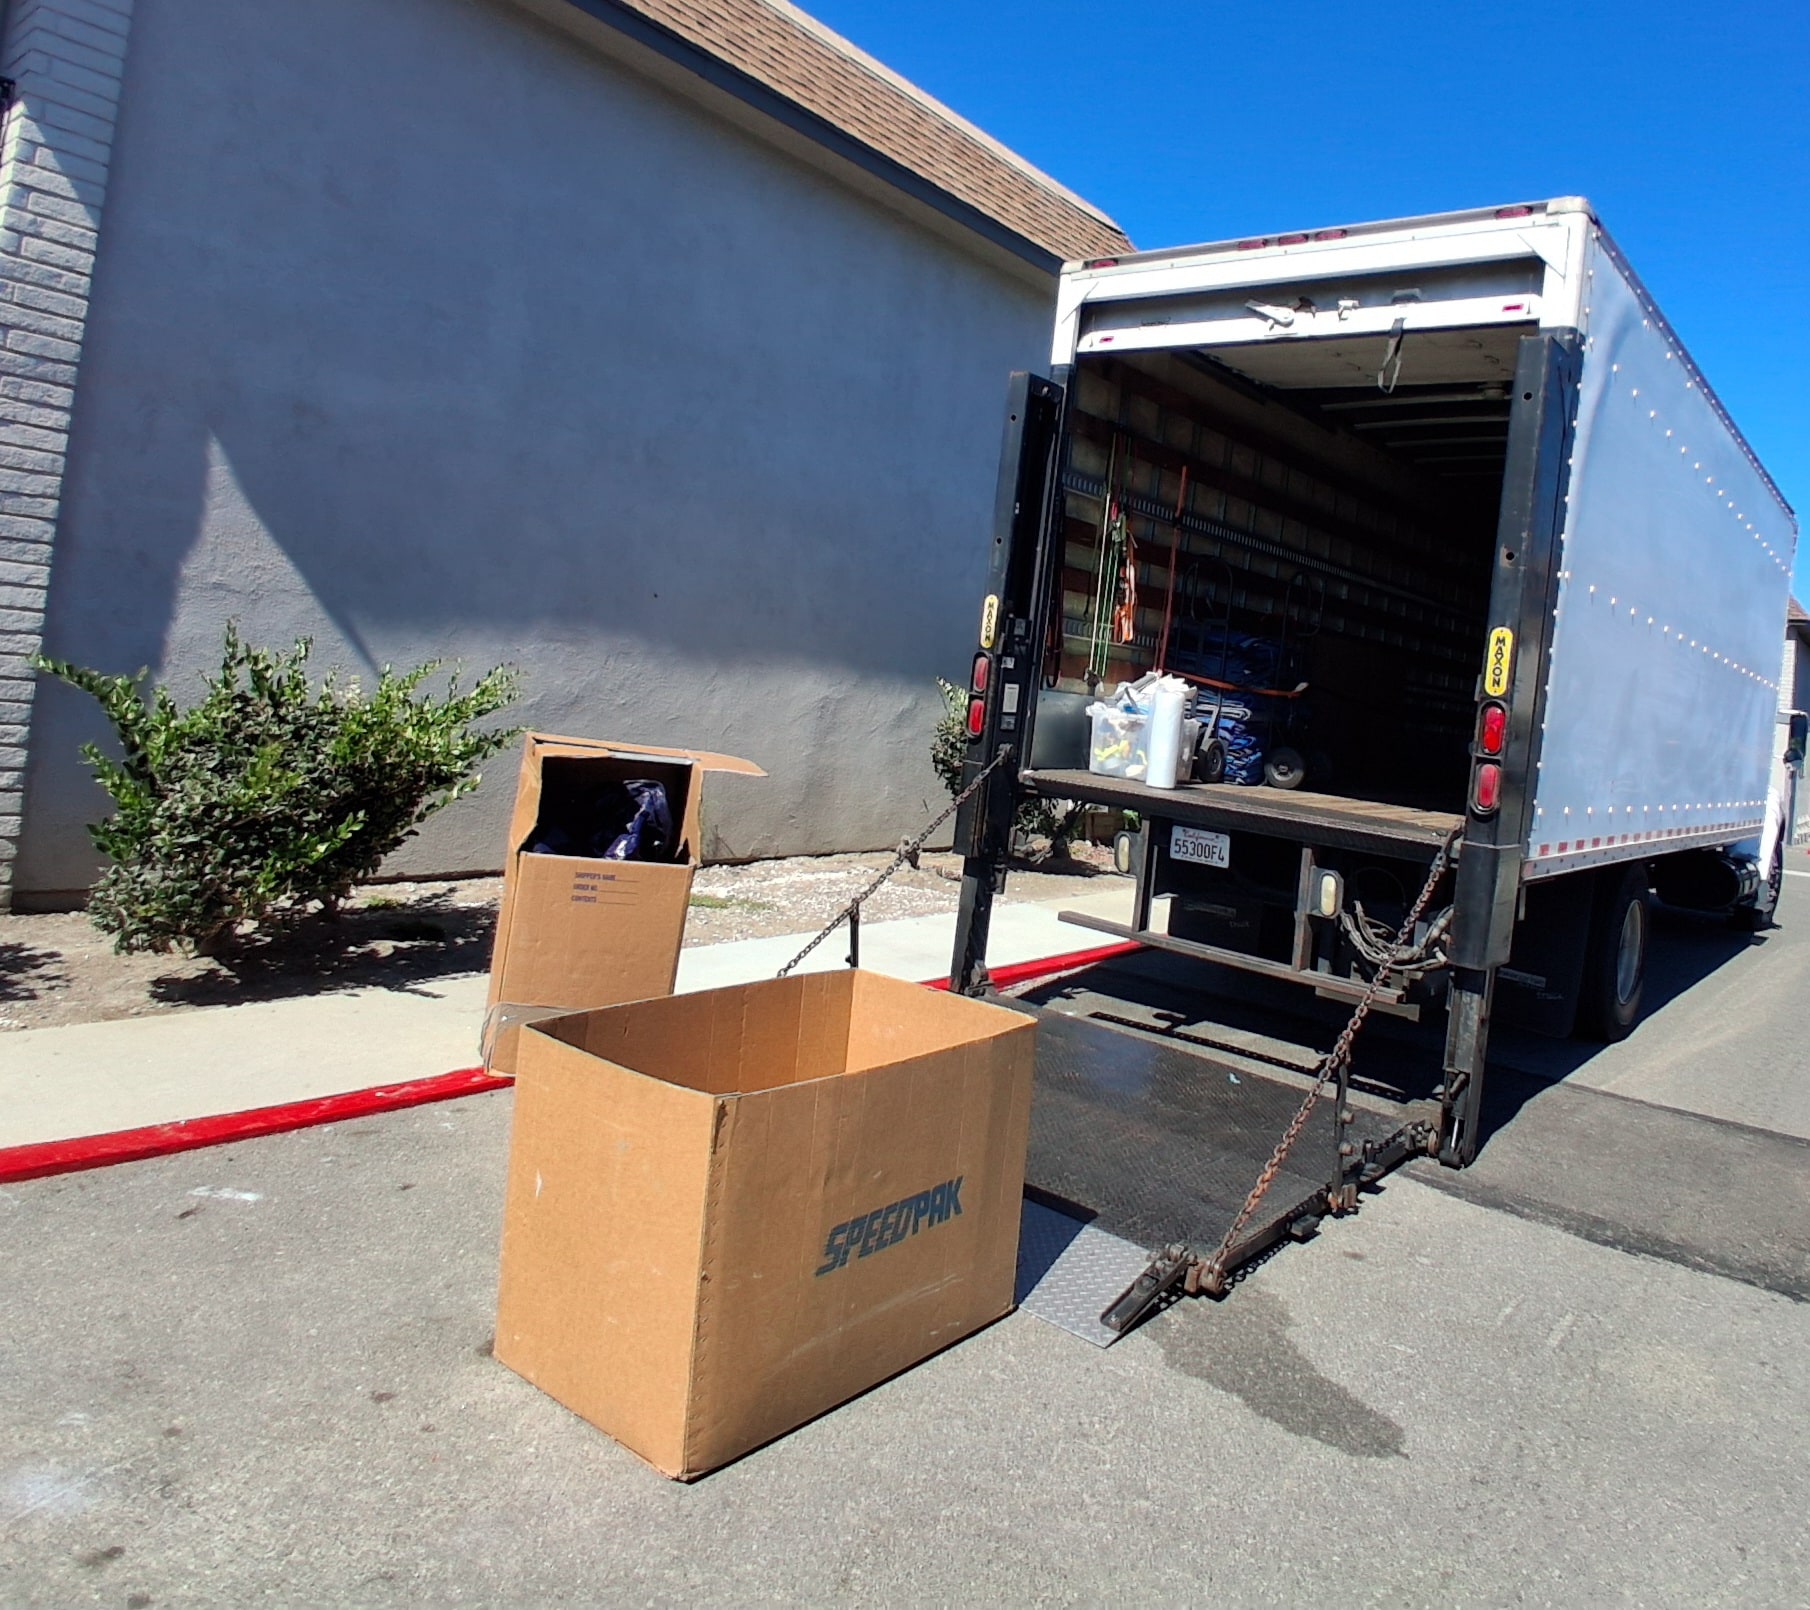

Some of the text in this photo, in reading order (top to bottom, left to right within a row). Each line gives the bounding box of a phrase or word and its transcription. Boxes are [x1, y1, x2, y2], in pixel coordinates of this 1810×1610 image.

[985, 601, 995, 642] MAXON
[1492, 635, 1506, 688] MAXON
[1174, 838, 1225, 862] 55300F4
[815, 1175, 964, 1277] SPEEDPAK
